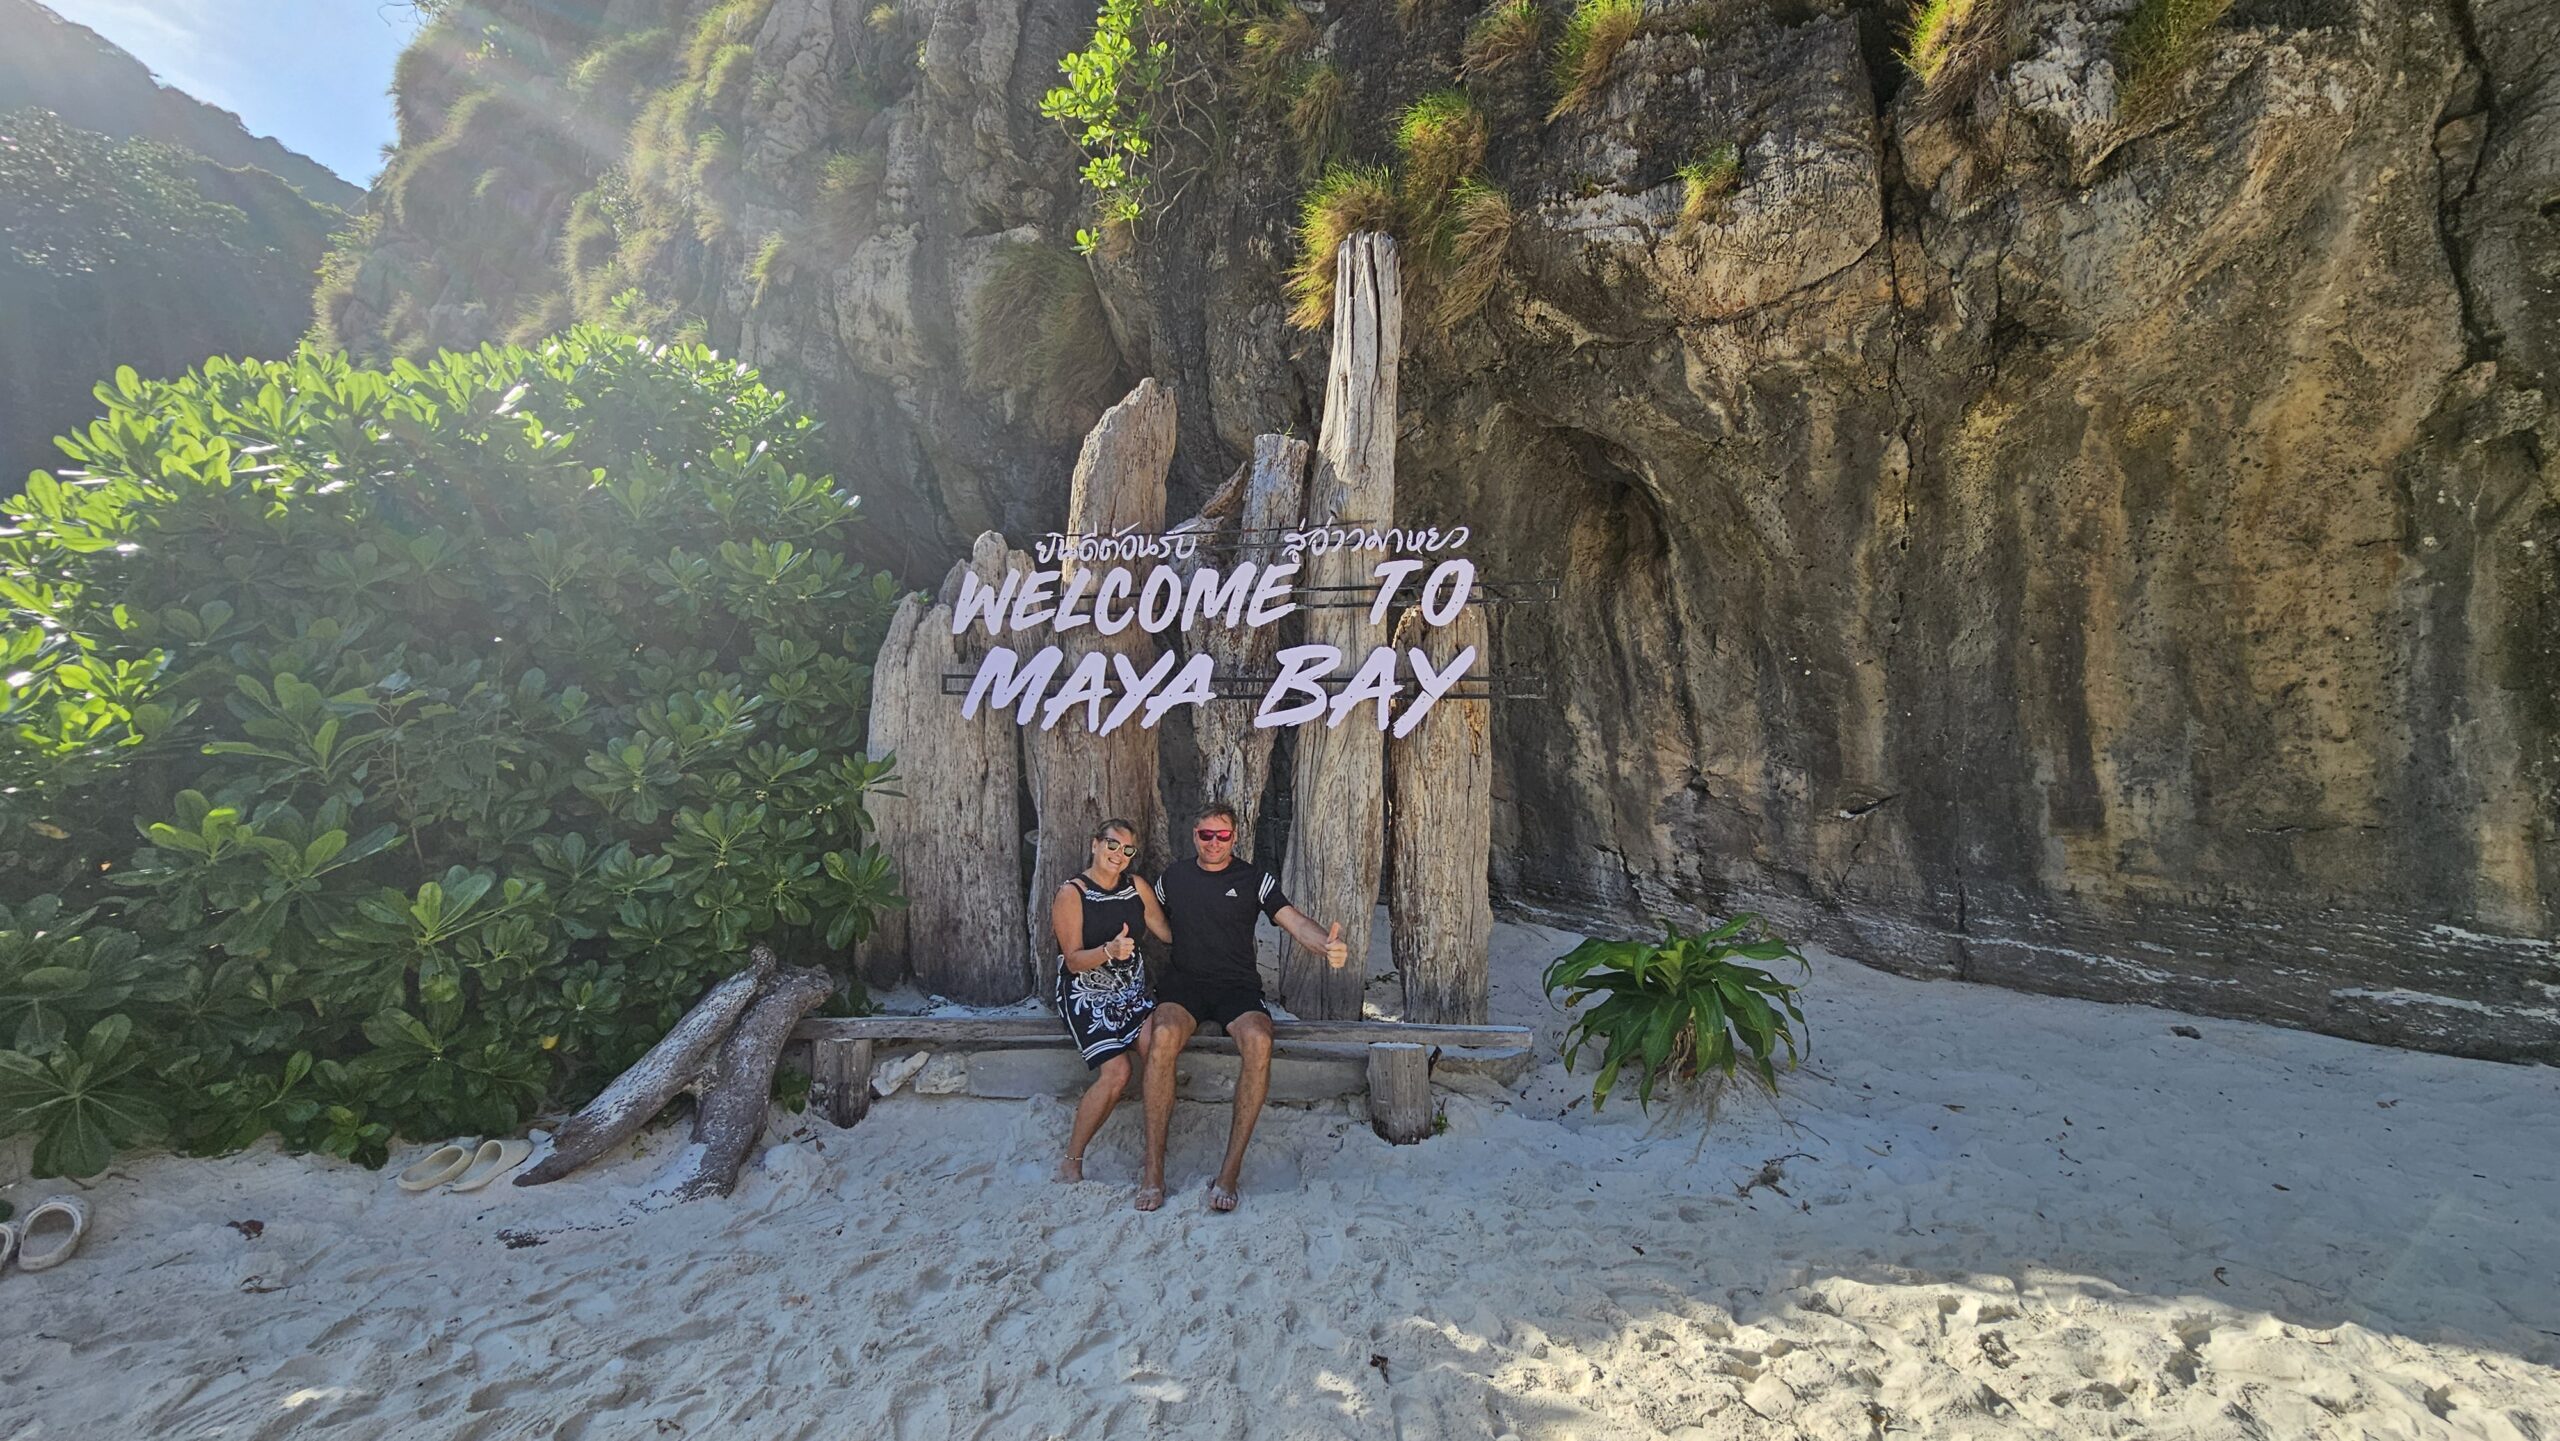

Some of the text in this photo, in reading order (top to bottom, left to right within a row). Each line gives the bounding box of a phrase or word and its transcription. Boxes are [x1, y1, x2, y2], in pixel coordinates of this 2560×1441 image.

[1035, 521, 1200, 564] ยินดีต้อนรับ
[952, 558, 1475, 636] WELCOME TO
[961, 644, 1476, 739] MAYA BAY
